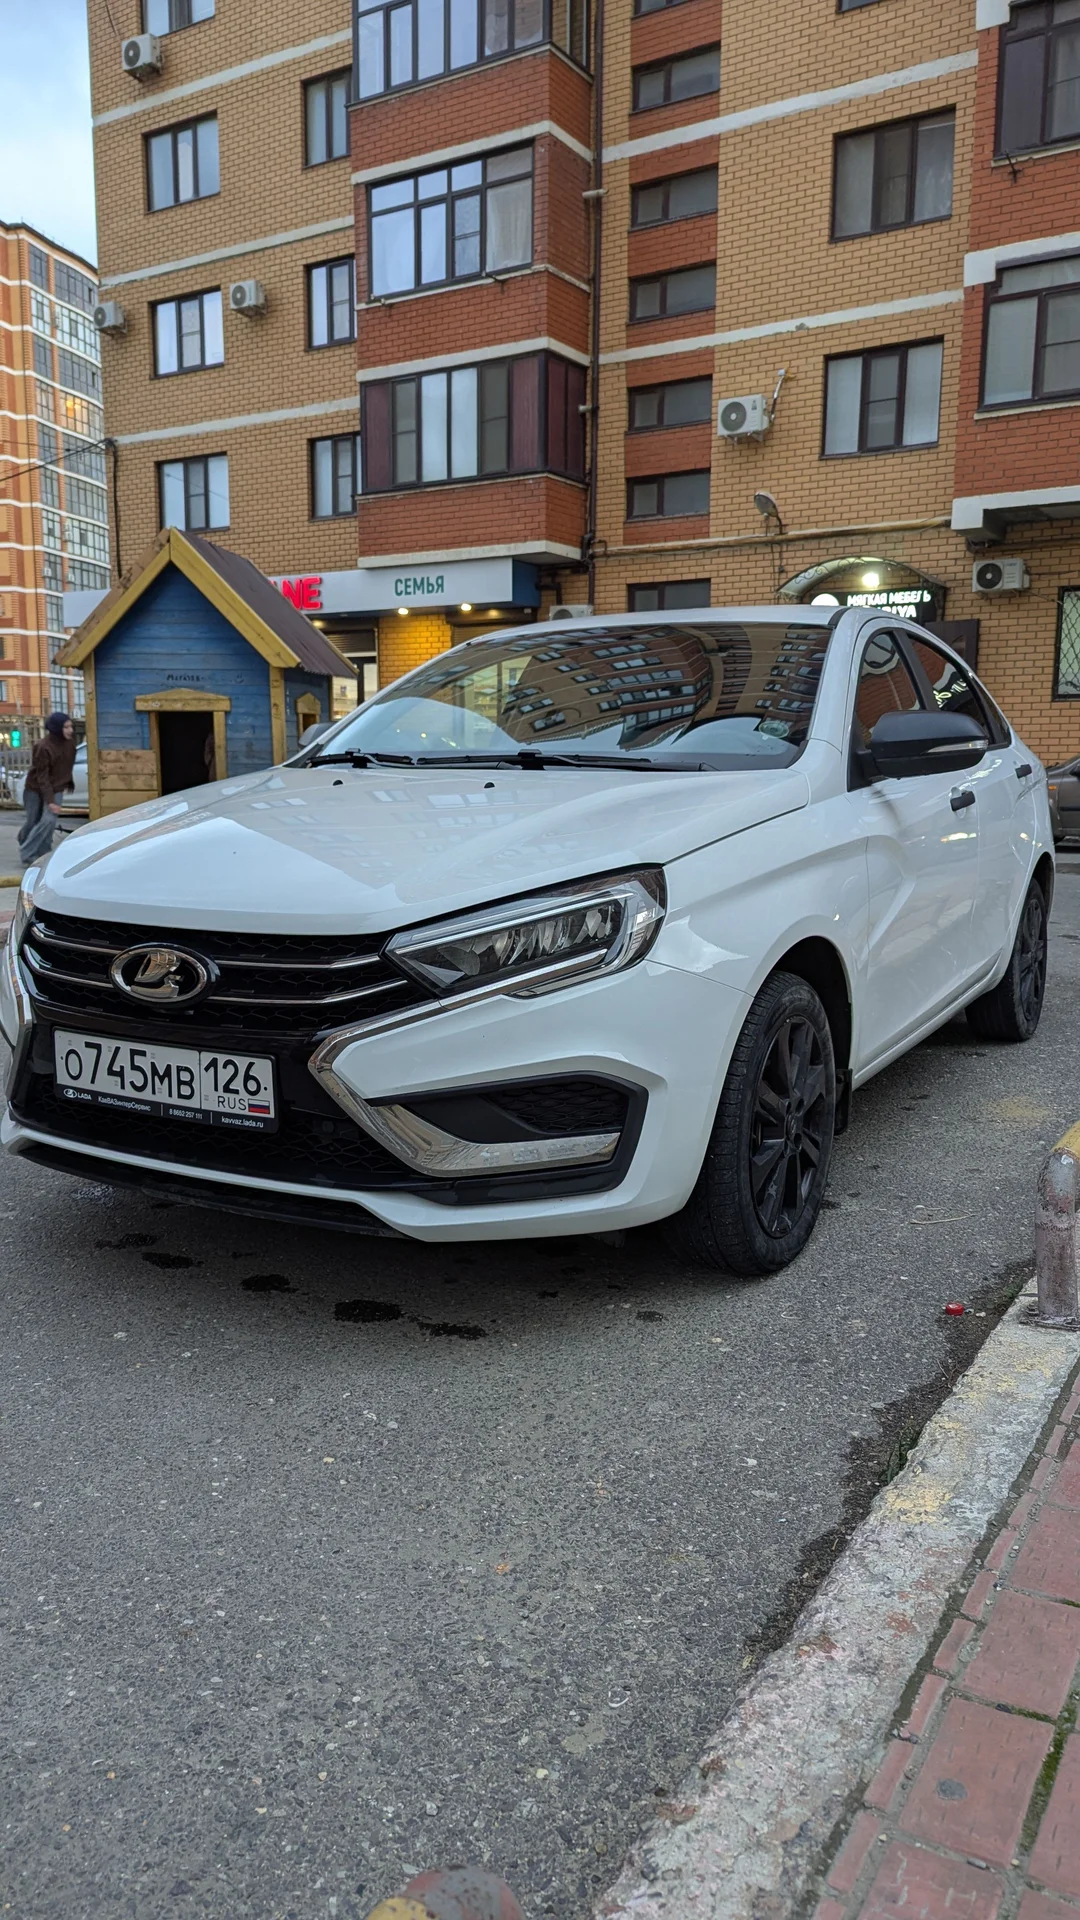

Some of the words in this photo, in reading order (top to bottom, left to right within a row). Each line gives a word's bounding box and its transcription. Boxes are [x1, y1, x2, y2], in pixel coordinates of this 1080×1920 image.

[271, 576, 322, 610] NE
[394, 575, 445, 597] СЕМЬЯ
[846, 593, 888, 607] МЯГКАЯ
[203, 1056, 262, 1097] 126
[77, 1091, 92, 1100] LADA
[217, 1095, 247, 1111] RUS
